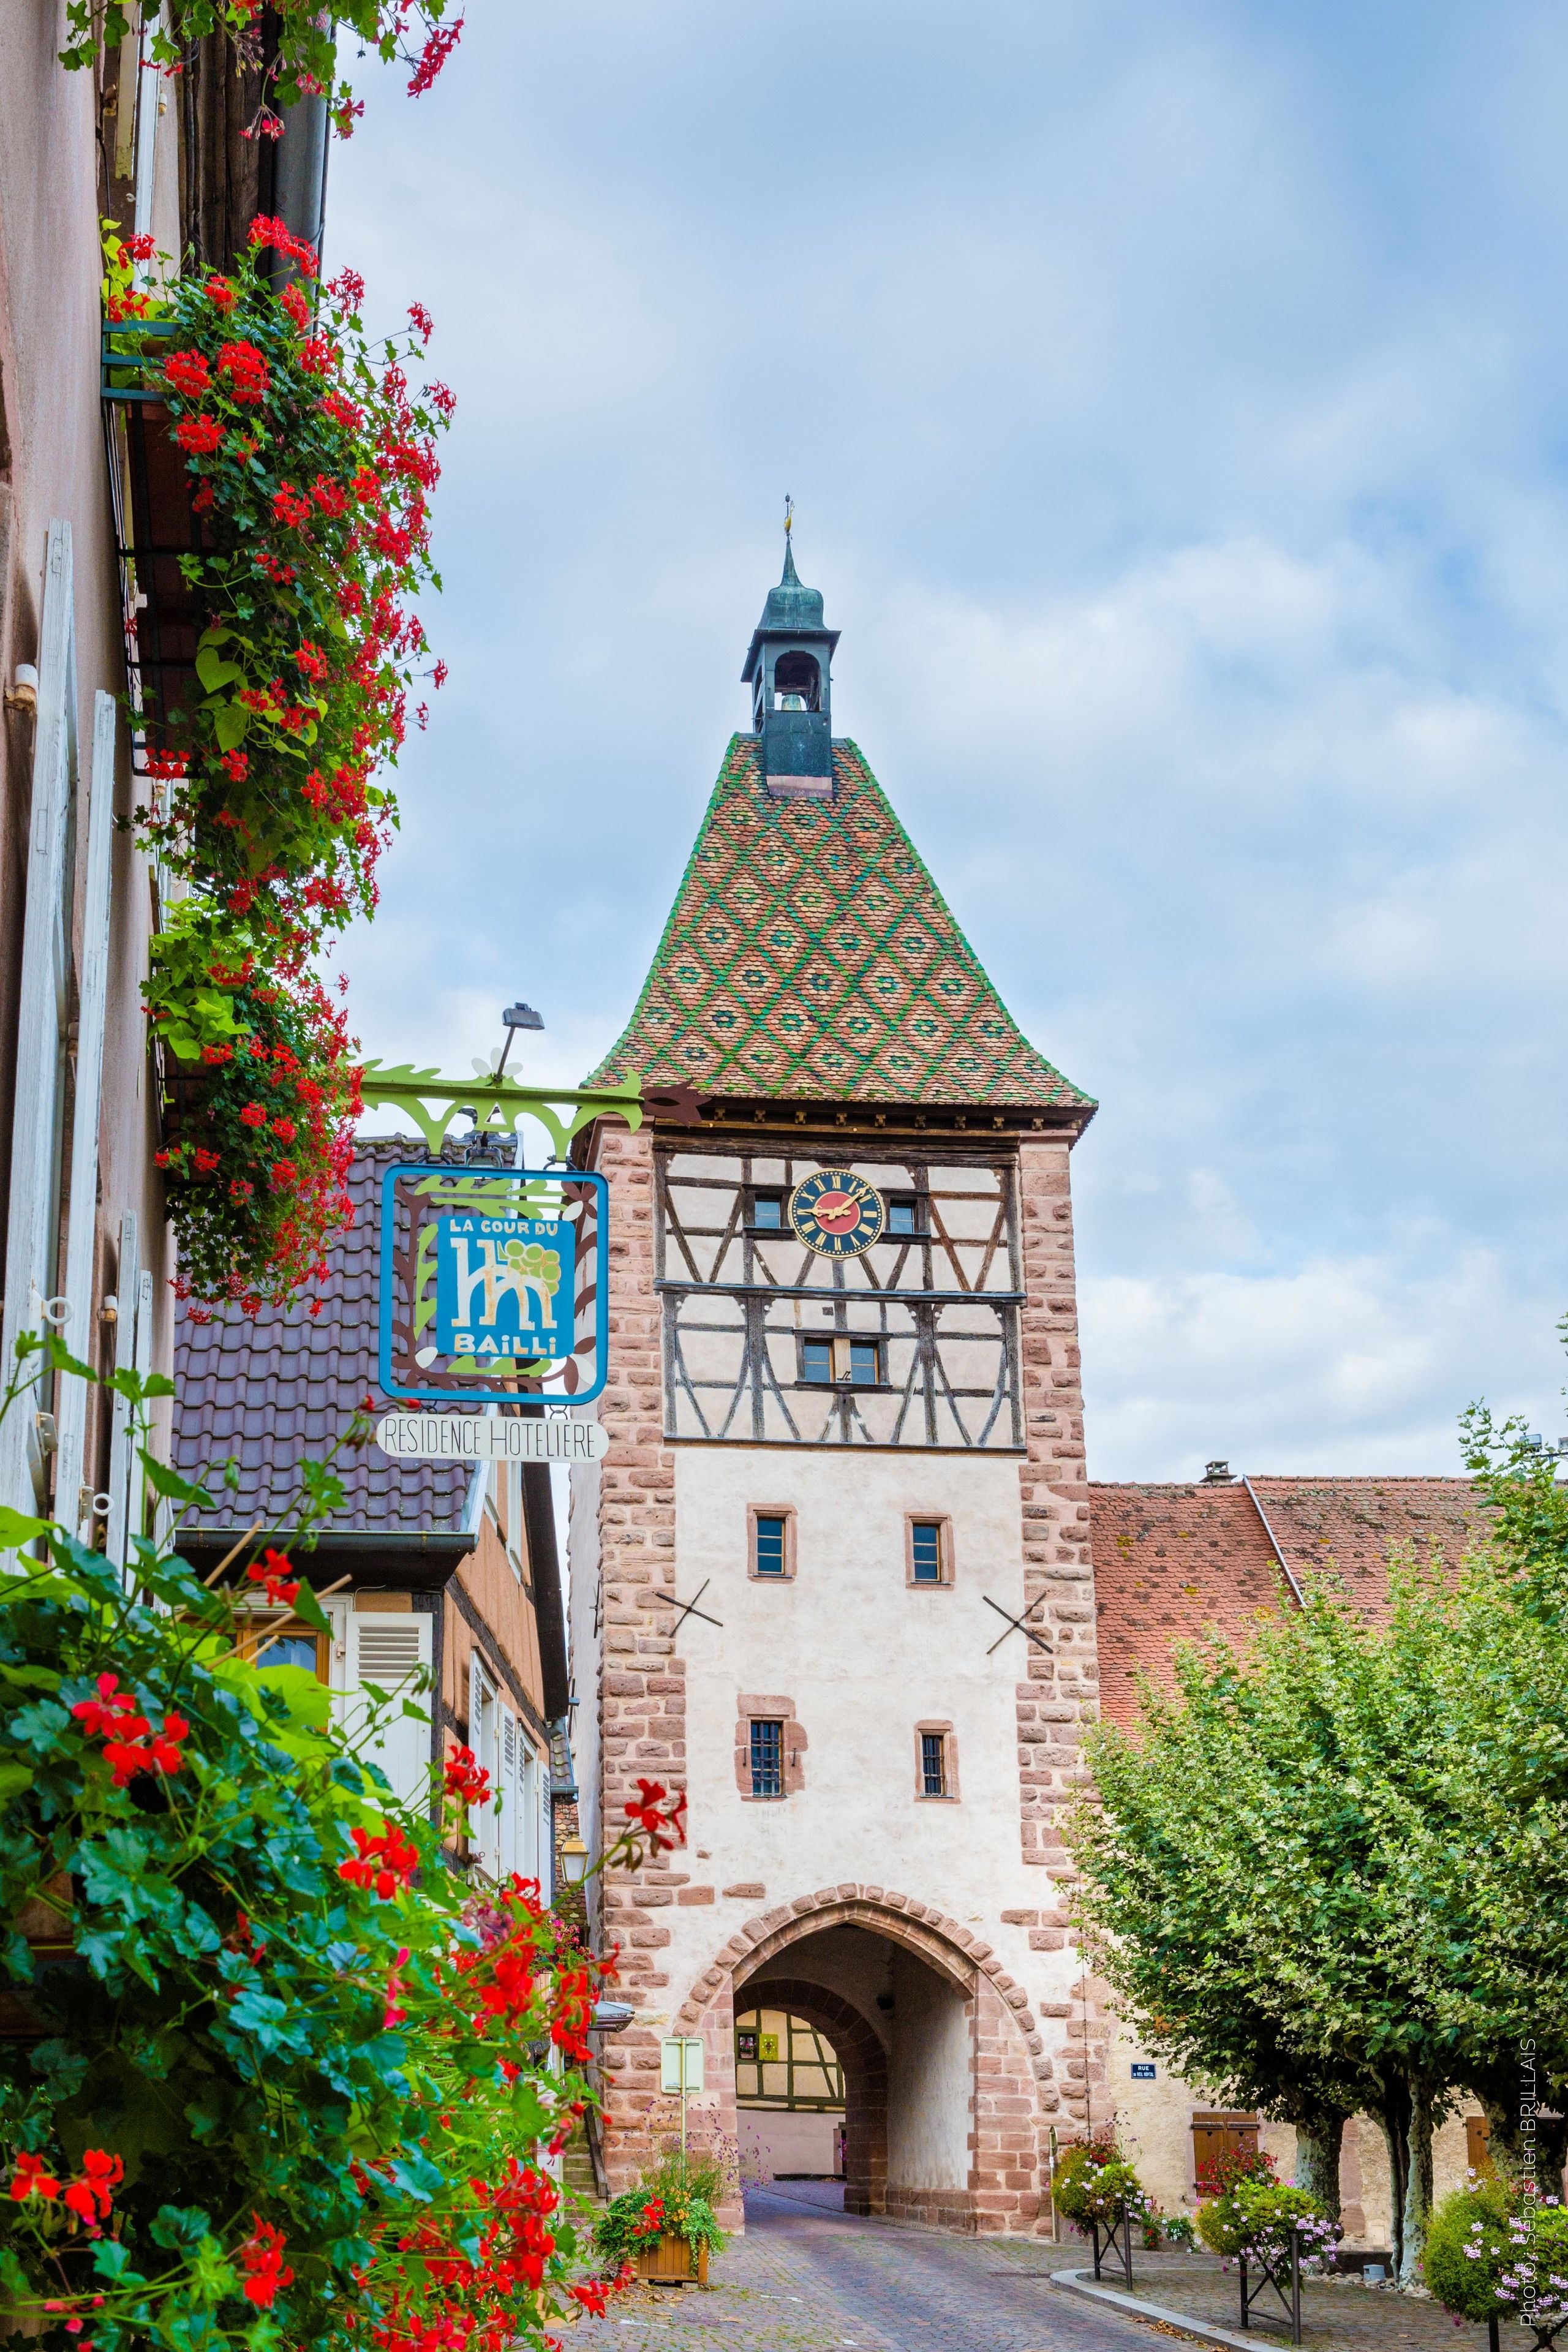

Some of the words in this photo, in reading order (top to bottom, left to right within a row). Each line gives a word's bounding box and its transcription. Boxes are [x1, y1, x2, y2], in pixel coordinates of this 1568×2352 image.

[832, 1175, 840, 1189] XII
[450, 1219, 473, 1232] LA
[481, 1220, 529, 1234] COUR
[535, 1223, 558, 1236] DU
[385, 1419, 481, 1455] RESIDENCE
[491, 1420, 595, 1458] HOTELIERE
